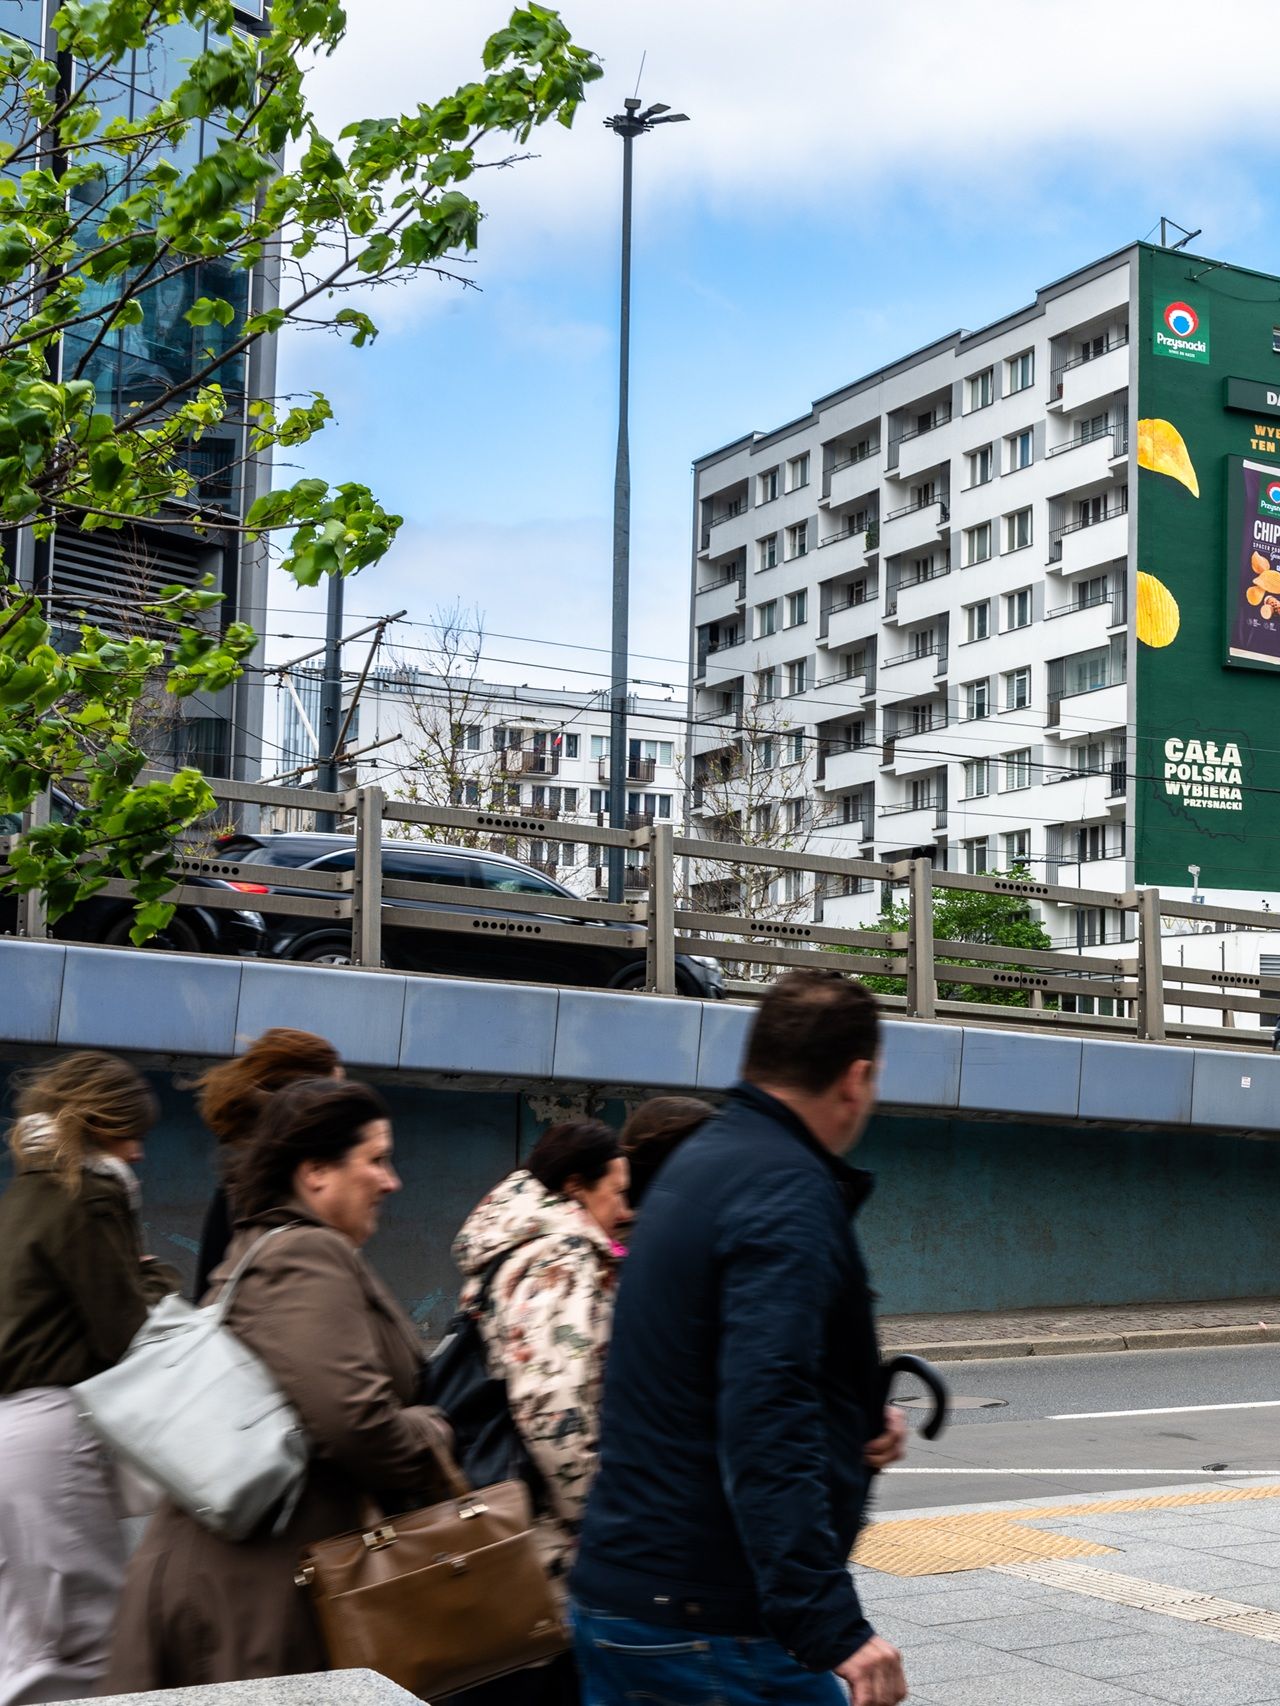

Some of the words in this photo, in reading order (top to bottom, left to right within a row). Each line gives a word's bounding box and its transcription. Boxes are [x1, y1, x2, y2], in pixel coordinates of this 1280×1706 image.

[1157, 332, 1206, 352] Przysnacki
[1250, 439, 1276, 453] TEN
[1165, 738, 1242, 767] CAŁA
[1165, 763, 1242, 784] POLSKA
[1165, 781, 1242, 800] WYBIERA
[1184, 798, 1242, 810] PRZYSNACKI
